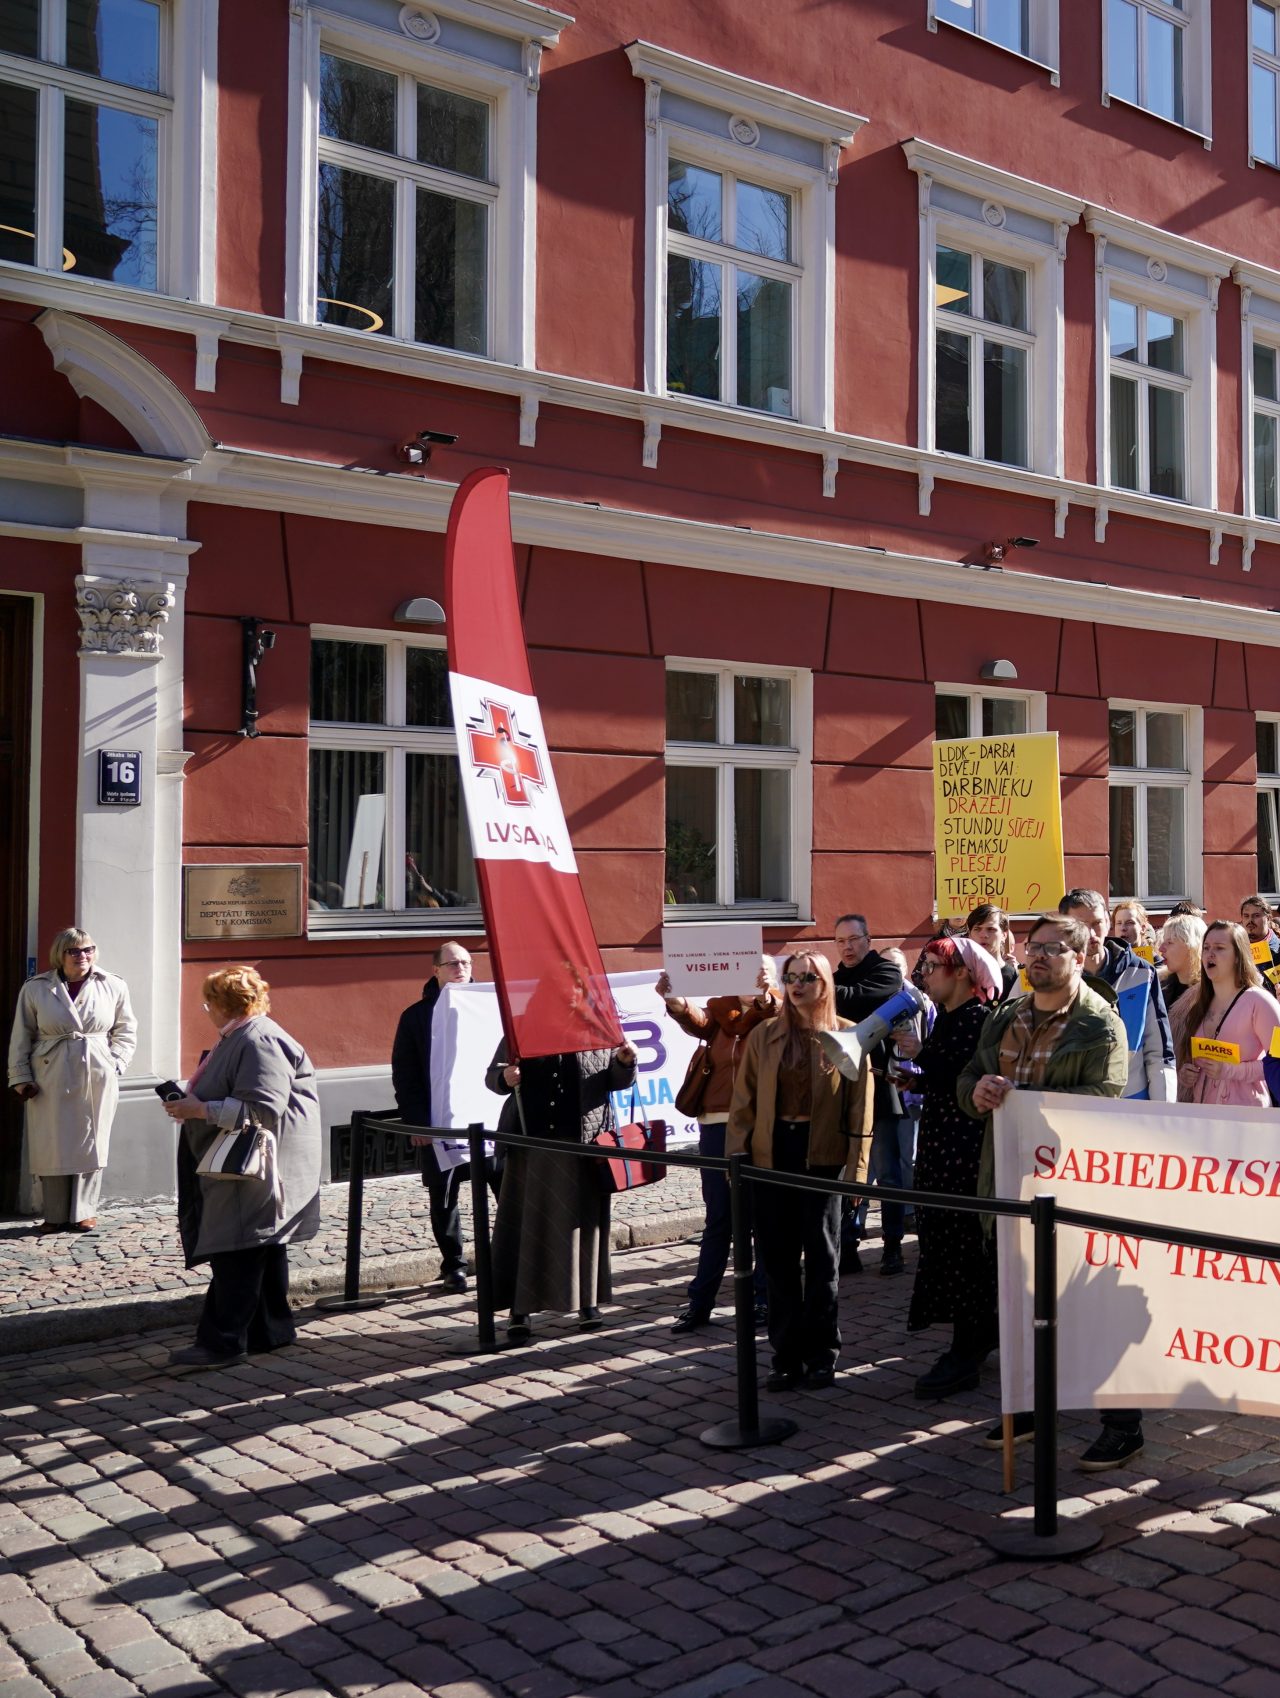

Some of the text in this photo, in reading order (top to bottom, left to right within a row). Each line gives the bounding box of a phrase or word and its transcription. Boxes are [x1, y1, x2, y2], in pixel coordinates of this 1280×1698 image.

[980, 743, 1016, 759] DARBA
[107, 761, 135, 784] 16
[943, 777, 1033, 798] DARBINIEKU
[944, 818, 1003, 836] STUNDU
[945, 838, 1008, 855] PIEMAKSU
[945, 875, 1006, 896] TIESĪBU
[200, 908, 287, 918] DEPUTĀTU FRAKCIJAS
[686, 962, 730, 972] VISIEM
[1199, 1043, 1233, 1056] LAKRS
[1084, 1231, 1143, 1271] UN
